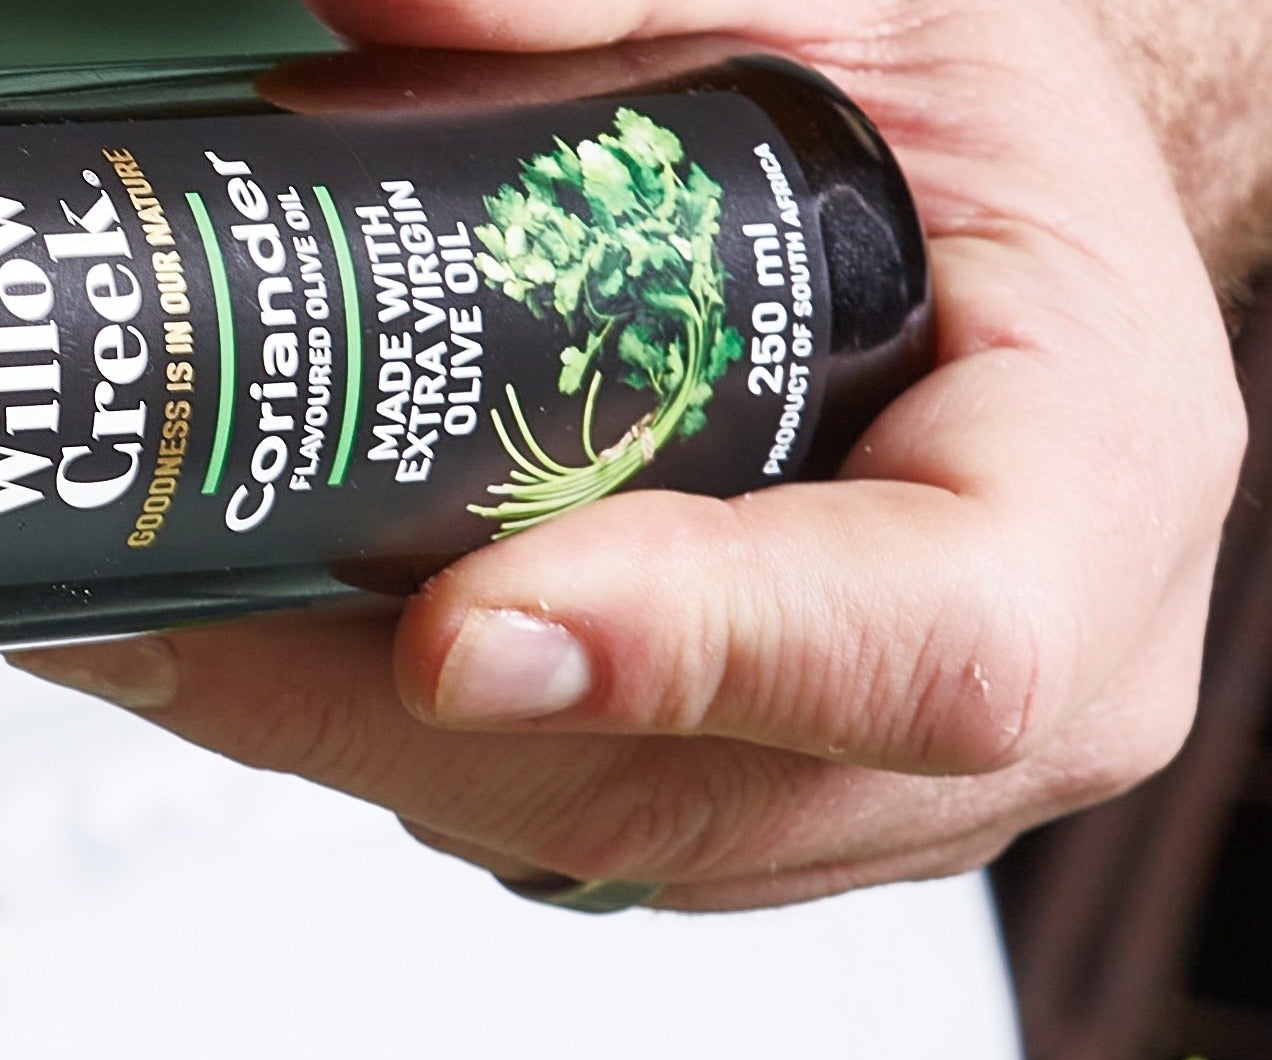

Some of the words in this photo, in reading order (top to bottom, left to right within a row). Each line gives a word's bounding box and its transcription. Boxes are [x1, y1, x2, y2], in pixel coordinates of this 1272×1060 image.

[102, 147, 176, 246] NATURE
[277, 186, 310, 231] OIL
[753, 142, 802, 228] AFRICA
[152, 249, 192, 316] OUR
[294, 235, 330, 320] OLIVE
[355, 205, 412, 323] WITH
[381, 180, 448, 333] VIRGIN
[437, 221, 480, 295] OIL
[742, 222, 785, 287] ml
[784, 231, 813, 318] SOUTH
[165, 321, 194, 354] IN
[166, 361, 194, 391] IS
[204, 151, 300, 532] Coriander
[443, 305, 483, 436] OLIVE
[748, 301, 787, 396] 250
[792, 322, 813, 357] OF
[289, 326, 333, 491] FLAVOURED
[367, 331, 413, 461] MADE
[395, 341, 448, 483] EXTRA
[762, 362, 810, 475] PRODUCT
[127, 400, 192, 549] GOODNESS
